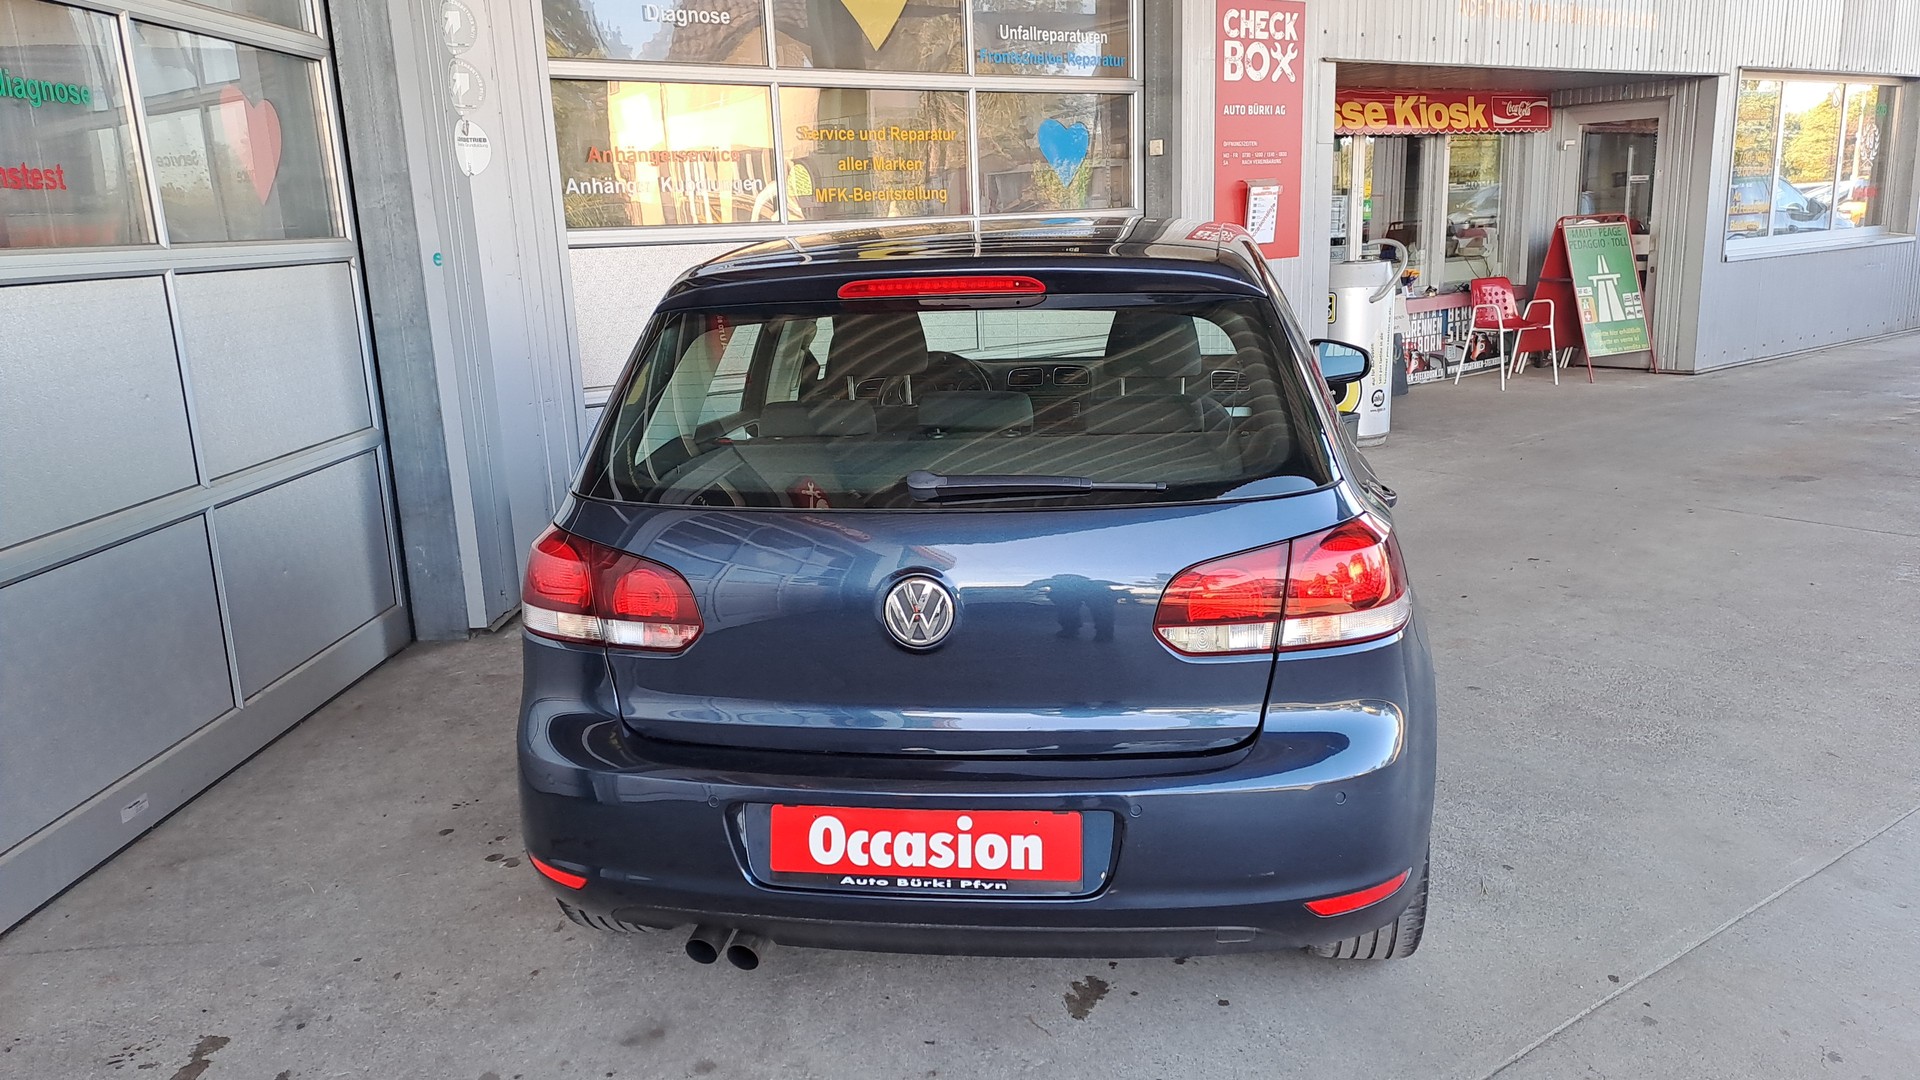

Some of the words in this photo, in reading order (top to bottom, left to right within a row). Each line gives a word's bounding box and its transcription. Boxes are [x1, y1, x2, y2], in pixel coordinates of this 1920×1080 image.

[645, 5, 731, 27] Diagnose
[1223, 8, 1299, 41] CHECK
[999, 24, 1108, 45] Unfallreparaturen
[1067, 51, 1126, 68] Reparatur
[1223, 40, 1299, 83] BOX
[1223, 104, 1246, 115] AUTO
[1248, 103, 1273, 115] BÜRKI
[1274, 104, 1286, 115] AG
[1394, 95, 1489, 129] Kiosk
[798, 125, 855, 142] Service
[859, 126, 886, 141] und
[890, 126, 957, 144] Reparatur
[587, 145, 740, 167] Anhängerservice
[838, 156, 869, 171] aller
[872, 156, 923, 171] Marken
[815, 187, 948, 203] MFK-Bereitstellung
[1571, 228, 1592, 238] MAUT
[1569, 238, 1606, 249] PEDAGGIO
[1611, 237, 1628, 247] TOLL
[433, 253, 443, 266] e
[1402, 317, 1443, 338] RENNEN
[808, 815, 1044, 871] Occasion
[840, 876, 889, 888] Auto
[897, 877, 952, 889] Bürki
[960, 879, 1007, 891] Pfyn
